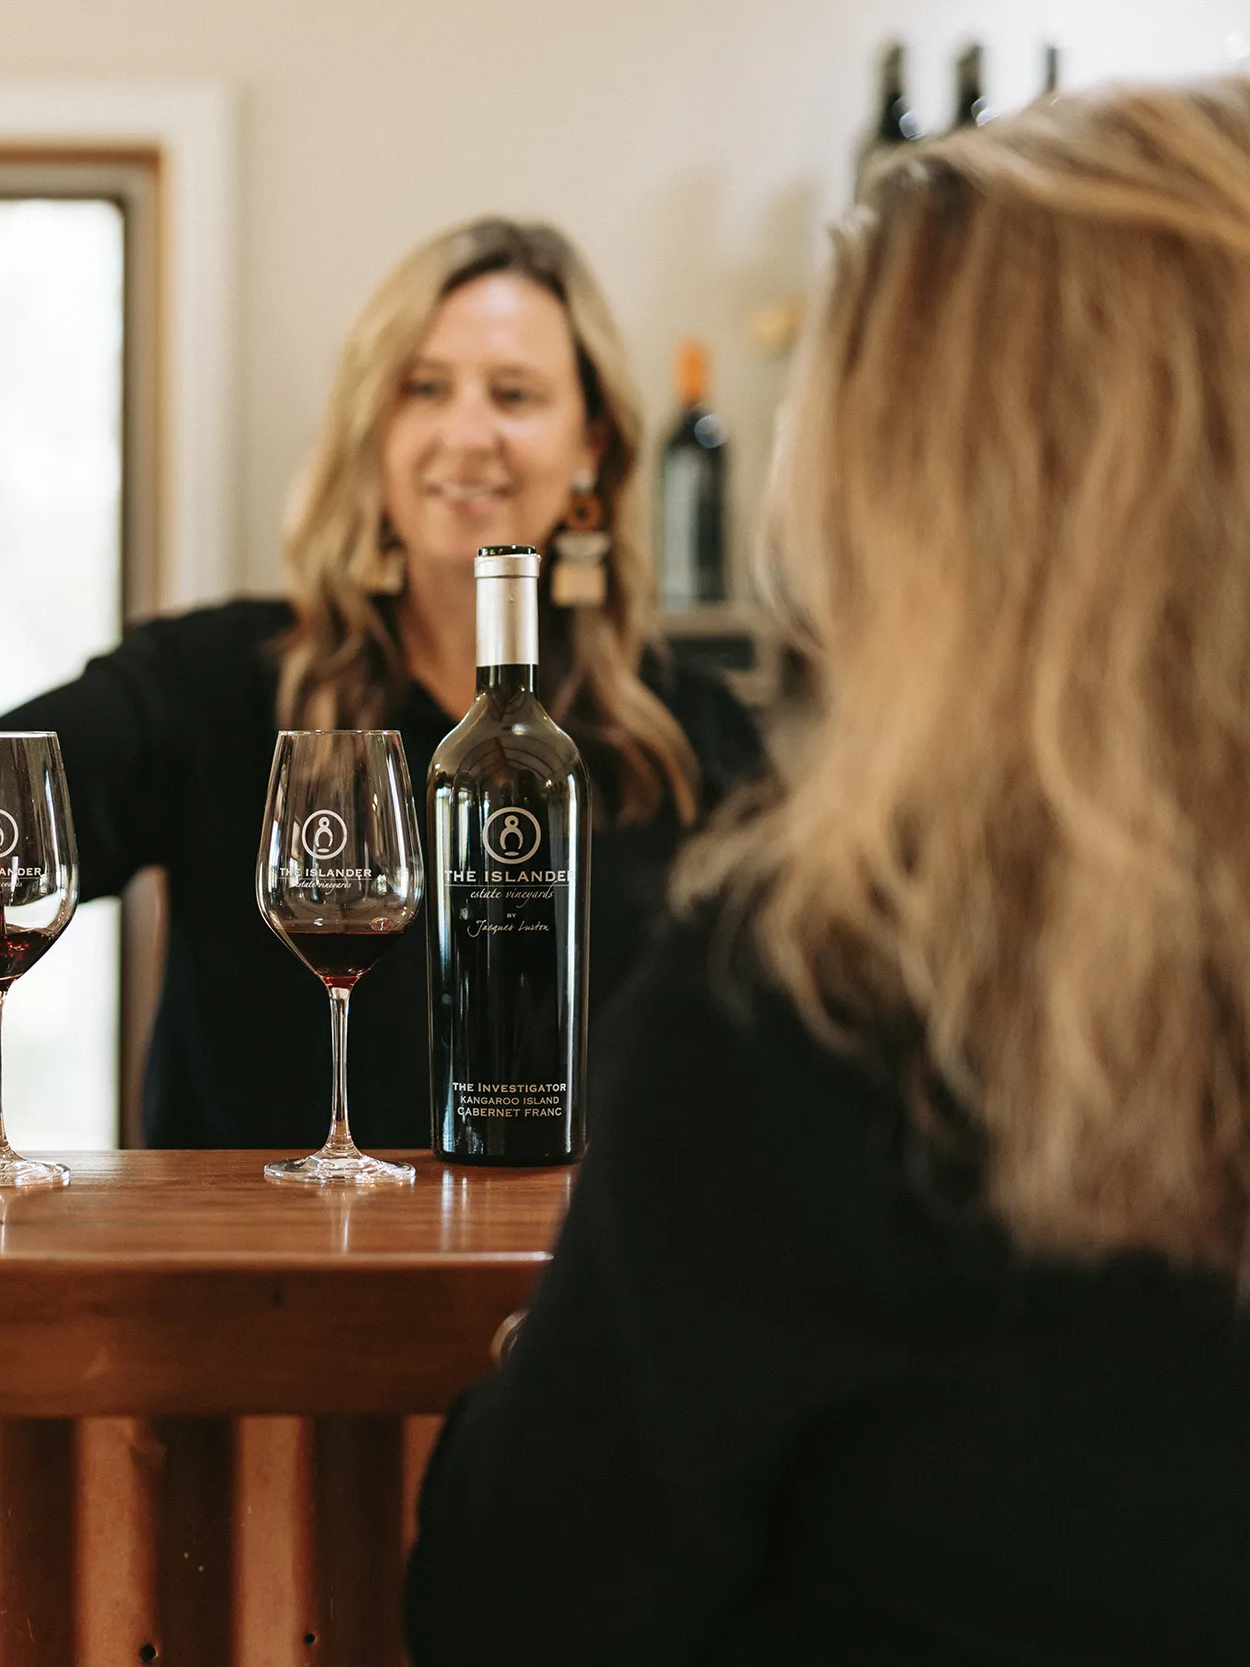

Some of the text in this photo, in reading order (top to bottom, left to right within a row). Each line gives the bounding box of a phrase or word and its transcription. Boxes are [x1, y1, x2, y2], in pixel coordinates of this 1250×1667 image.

[279, 868, 372, 877] THE ISLANDER
[444, 870, 575, 882] THE ISLANDER
[470, 880, 554, 908] estate vineyards
[467, 919, 515, 938] Jacques
[452, 1082, 567, 1093] THE INVESTIGATOR
[460, 1096, 560, 1105] KANGAROO ISLAND
[457, 1107, 562, 1117] CABERNET FRANC
